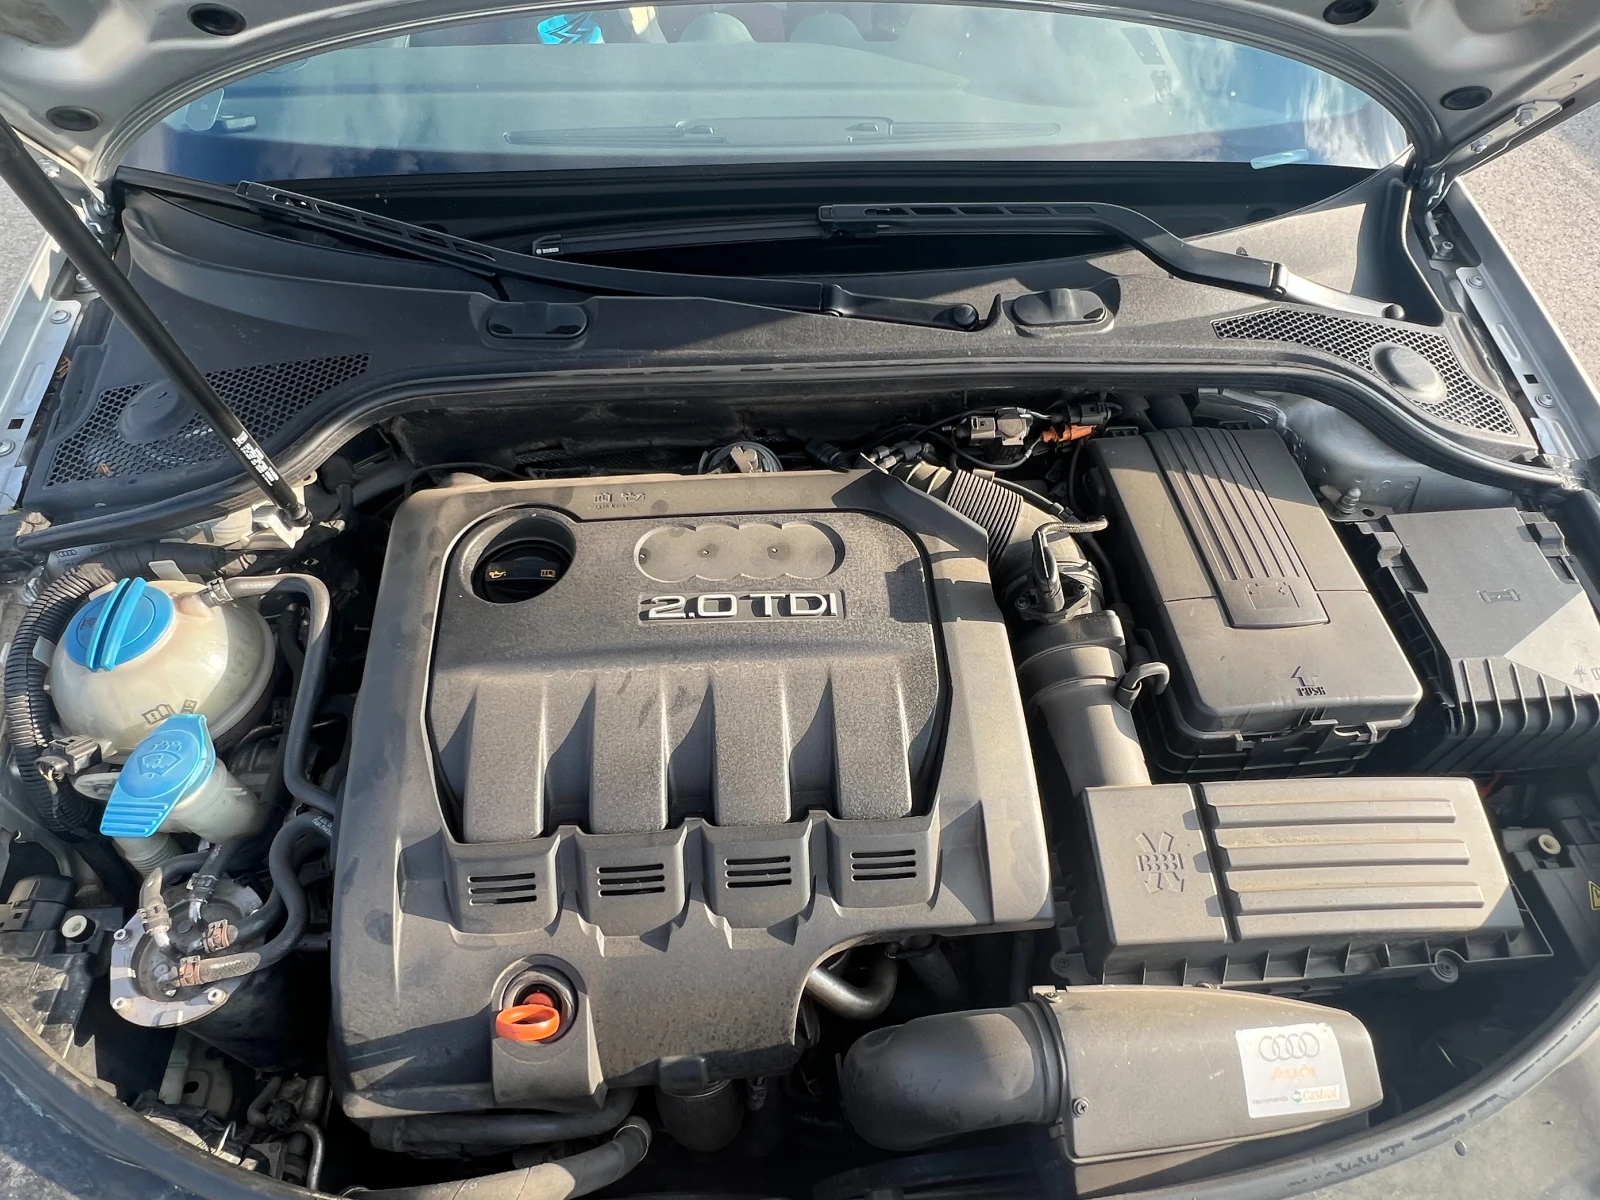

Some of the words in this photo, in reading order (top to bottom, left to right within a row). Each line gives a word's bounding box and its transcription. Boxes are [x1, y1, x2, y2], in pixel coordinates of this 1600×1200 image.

[648, 593, 738, 619] 2.0
[749, 592, 838, 618] TDI
[1295, 686, 1326, 697] PUSH
[1302, 1087, 1338, 1101] Castrol
